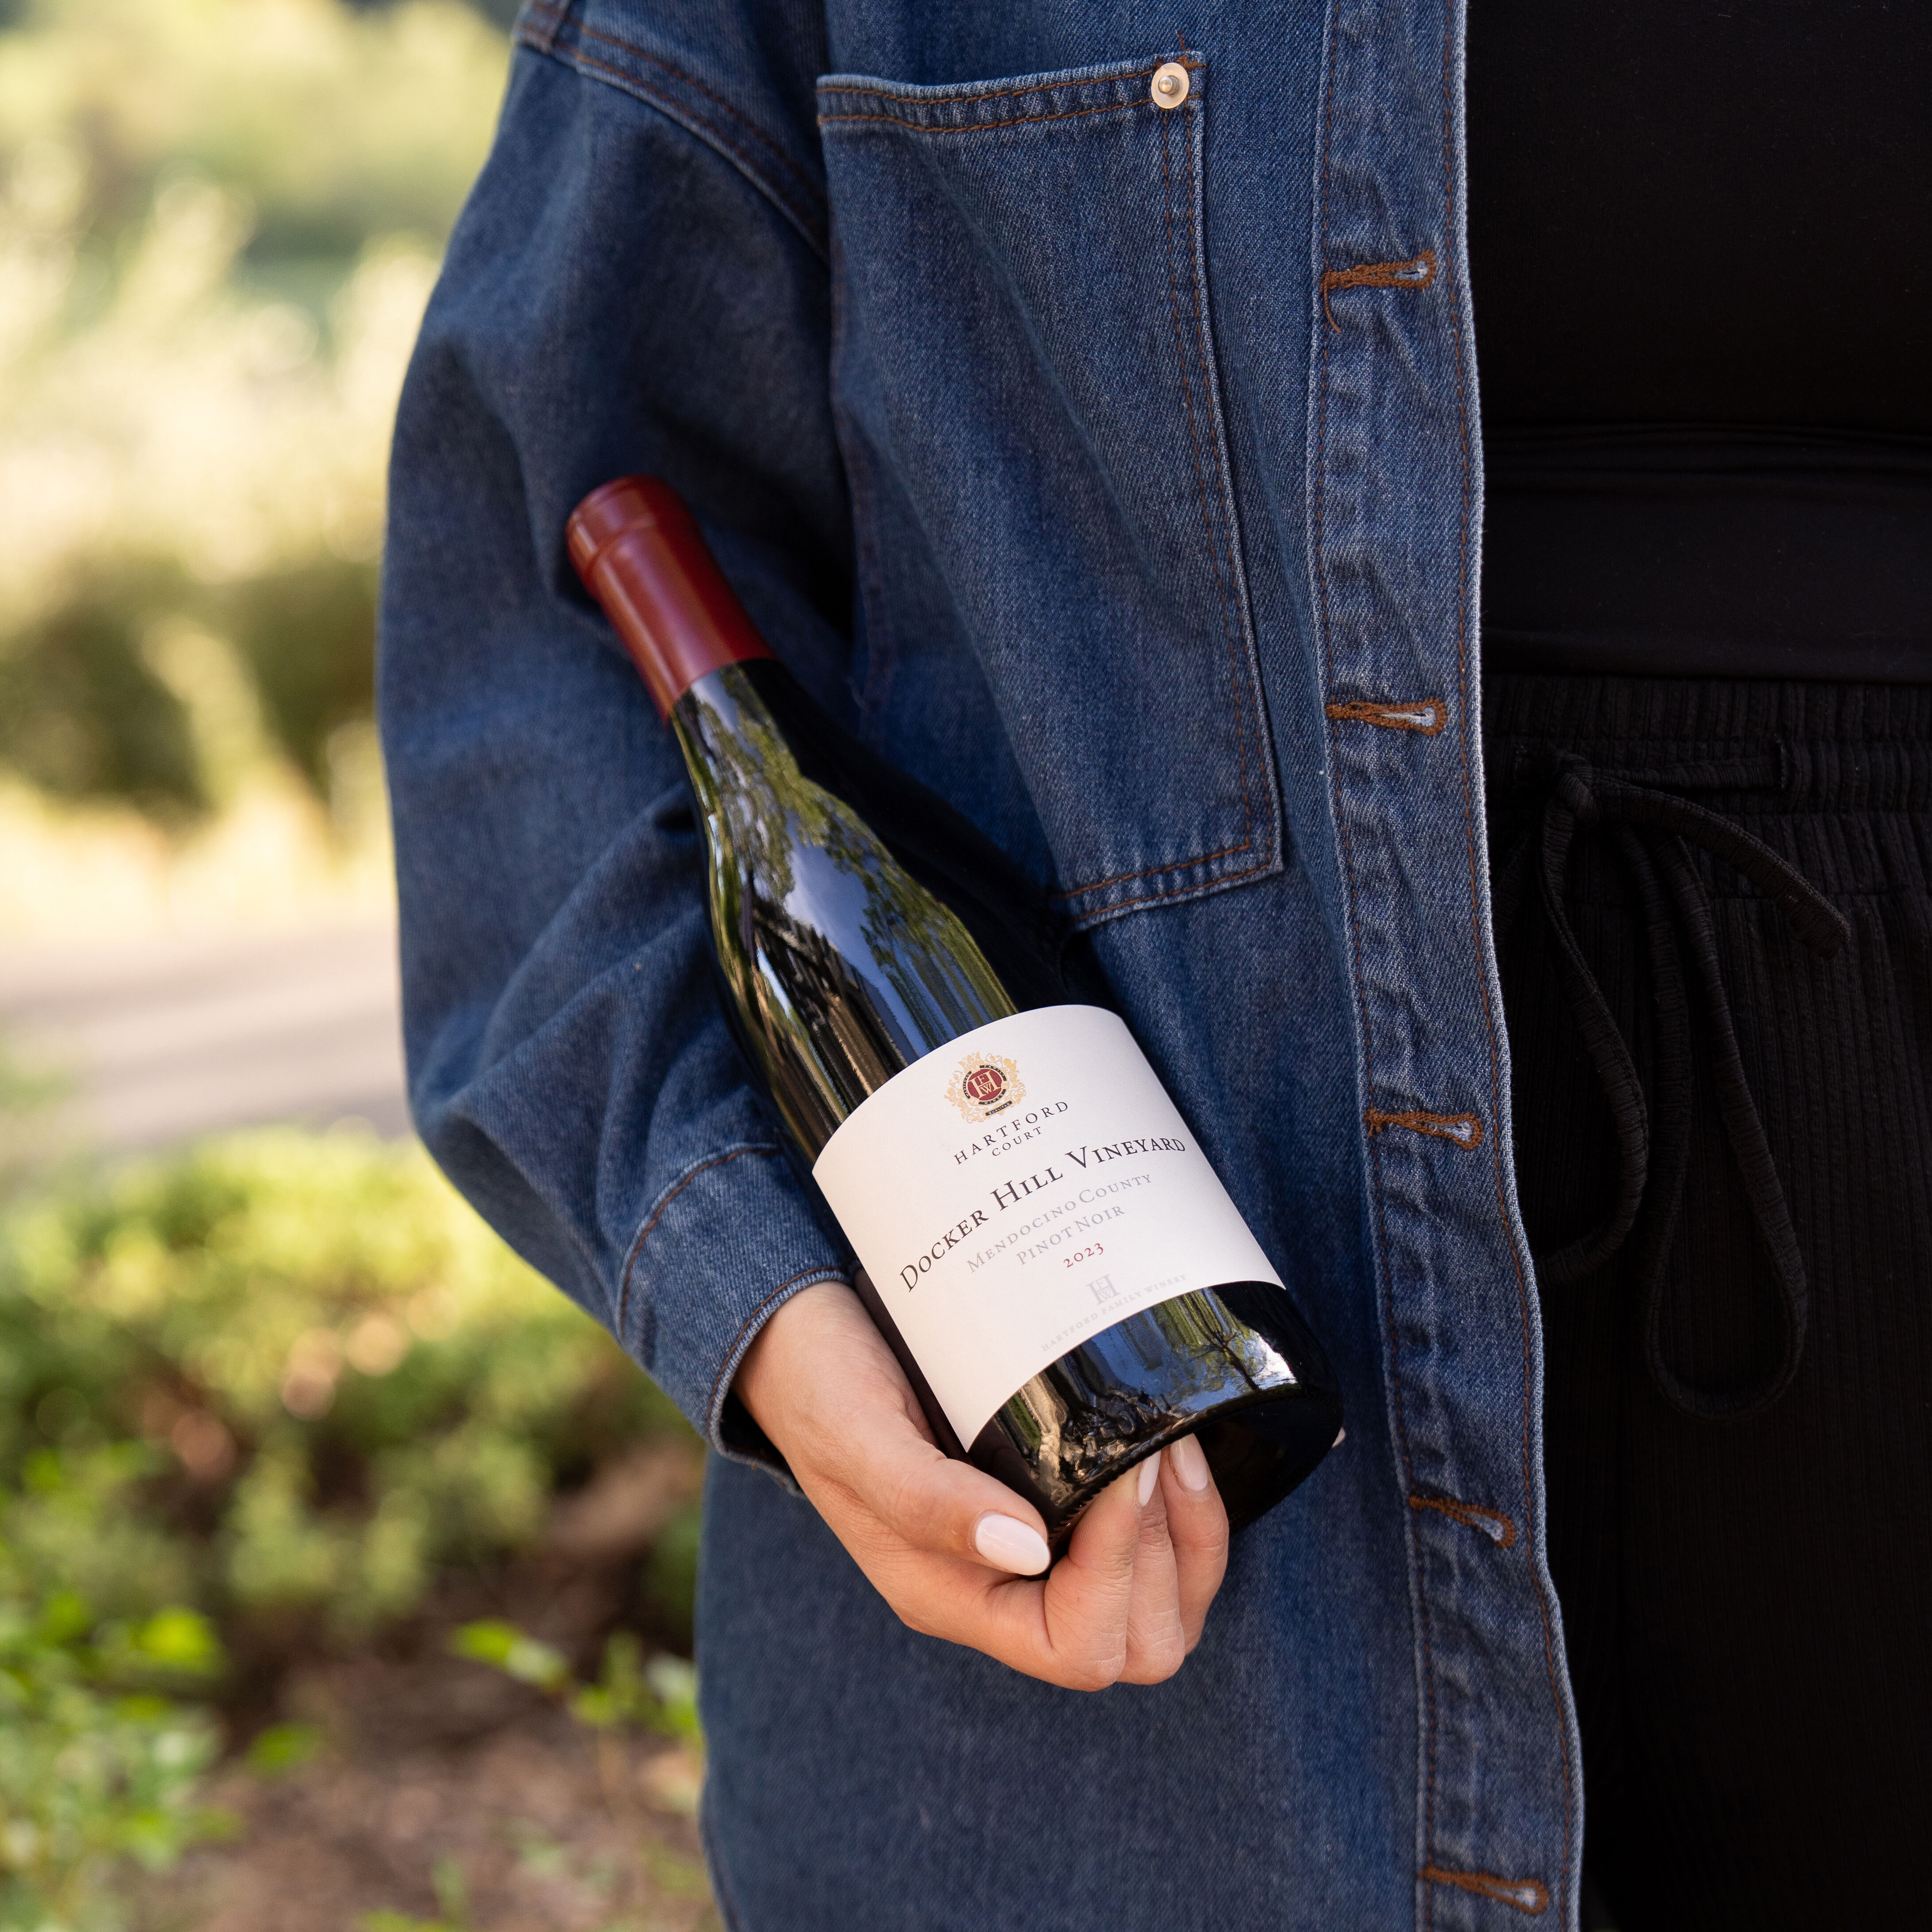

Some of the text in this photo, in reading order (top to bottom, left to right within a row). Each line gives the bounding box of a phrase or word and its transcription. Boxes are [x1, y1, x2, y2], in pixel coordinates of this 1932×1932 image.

[984, 1093, 1004, 1105] WINES
[988, 1102, 1011, 1115] QUALITAS
[954, 1101, 1068, 1165] HARTFORD
[992, 1126, 1042, 1156] COURT
[899, 1138, 1186, 1292] DOCKER HILL VINEYARD
[966, 1174, 1152, 1273] MENDOCINO COUNTY
[1016, 1206, 1125, 1266] PINOT NOIR
[1063, 1243, 1104, 1268] 2023
[1042, 1274, 1187, 1352] HARTFORD FAMILY WINERY
